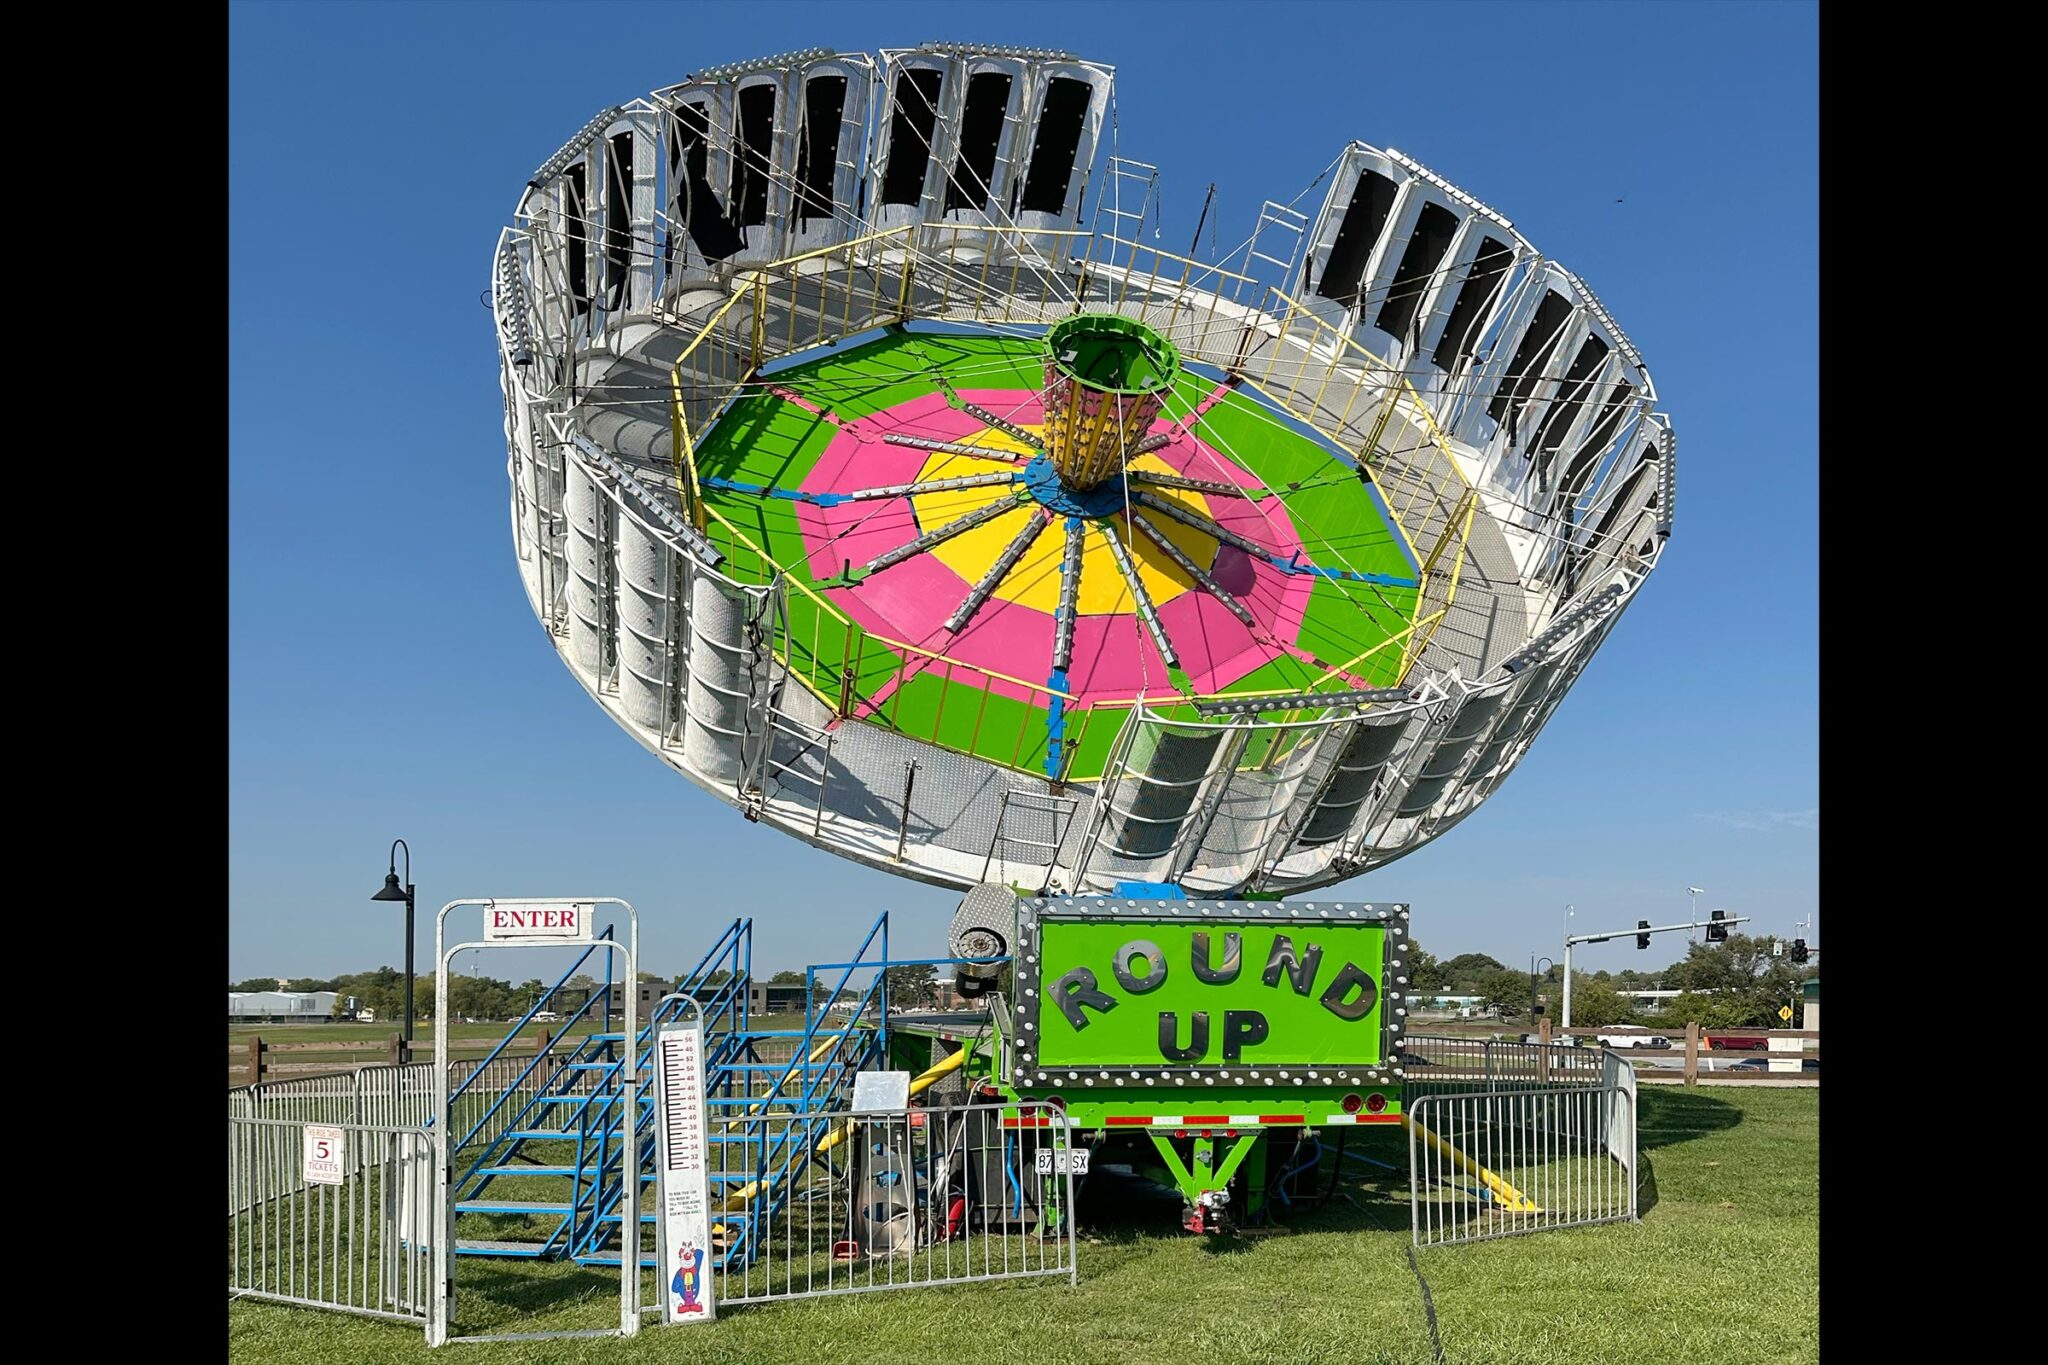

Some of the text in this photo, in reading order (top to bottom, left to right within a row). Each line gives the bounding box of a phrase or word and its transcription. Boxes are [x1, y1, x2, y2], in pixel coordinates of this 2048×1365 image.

[493, 910, 575, 928] ENTER
[1046, 932, 1379, 1032] ROUND
[1158, 1010, 1269, 1062] UP
[316, 1141, 329, 1159] 5
[308, 1162, 339, 1172] TICKETS
